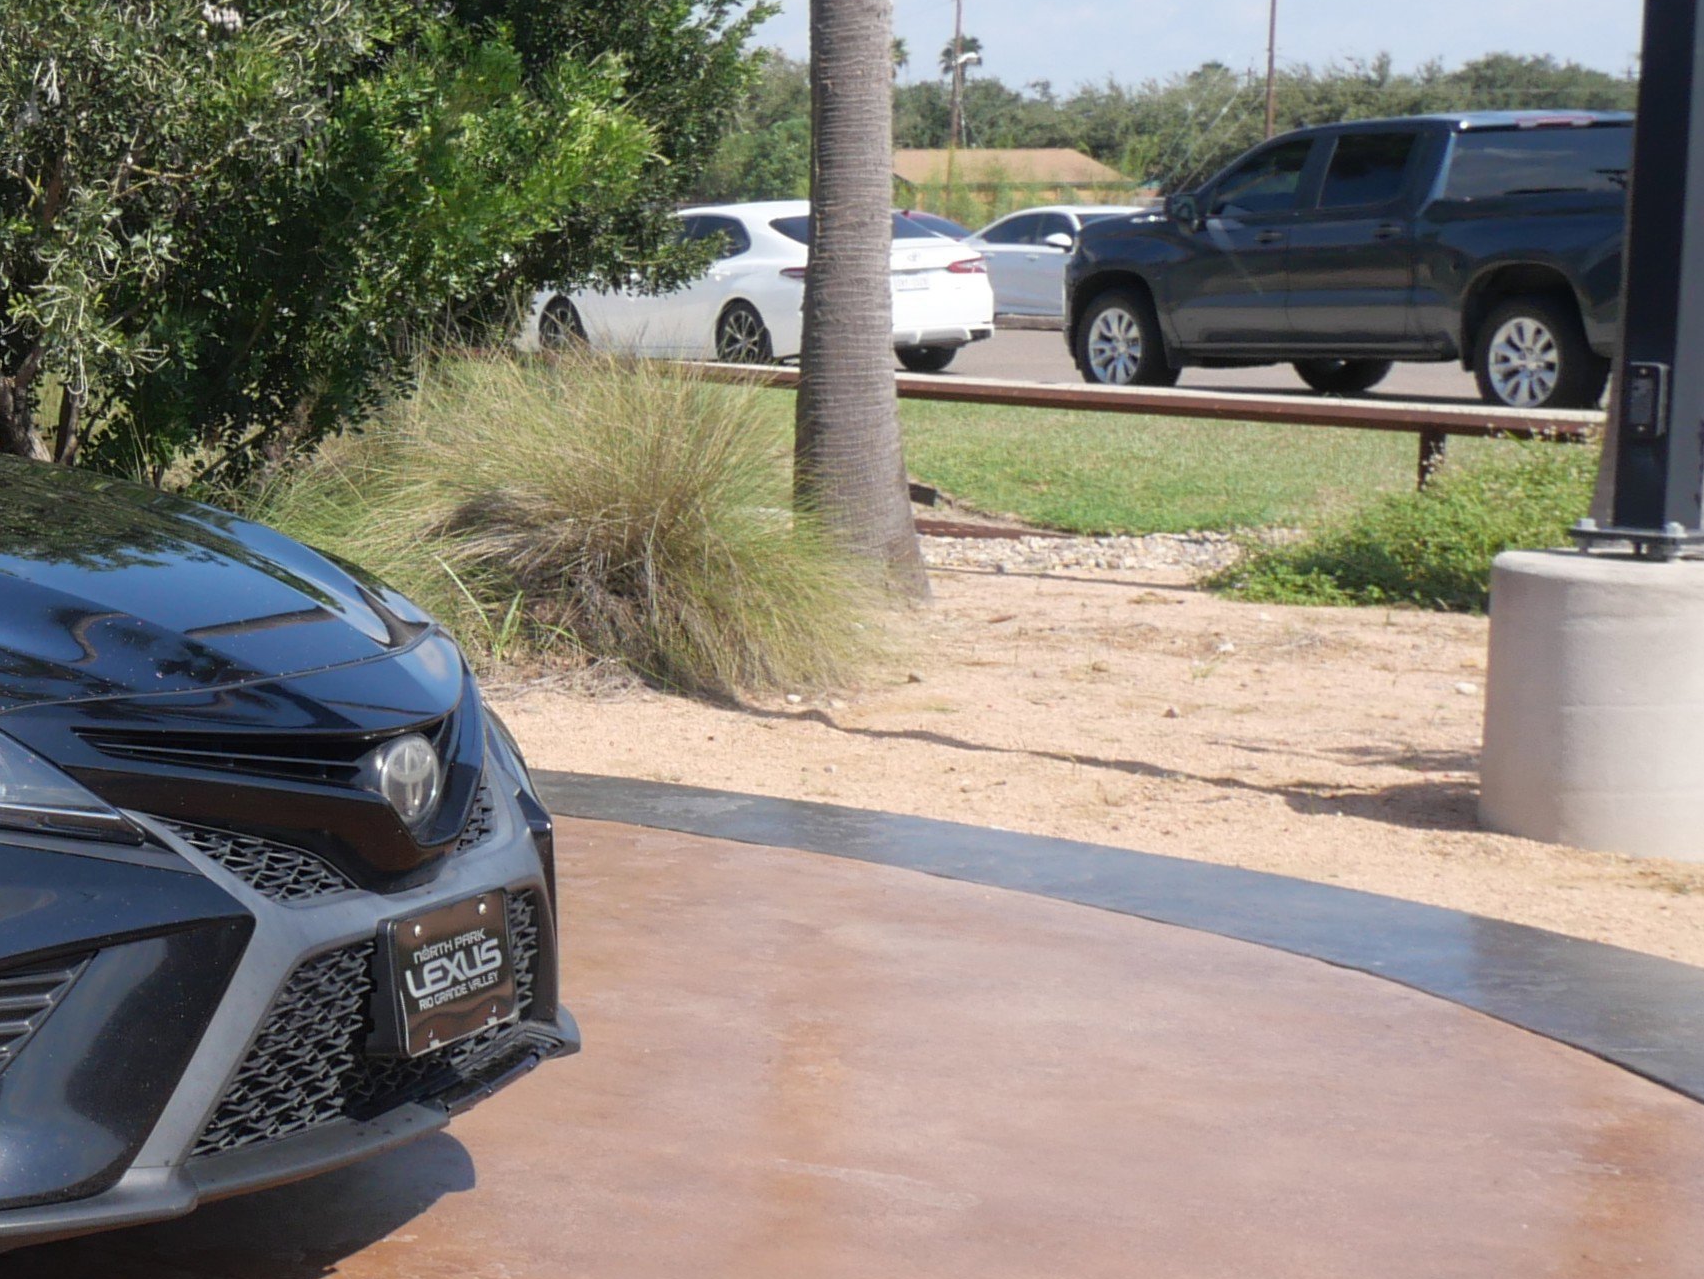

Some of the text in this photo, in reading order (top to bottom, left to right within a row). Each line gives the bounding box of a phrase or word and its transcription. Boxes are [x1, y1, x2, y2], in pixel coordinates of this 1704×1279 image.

[413, 928, 486, 964] NORTH PARK
[405, 938, 502, 999] LEXUS
[418, 970, 499, 1011] RIO GRANDE VALLEY
